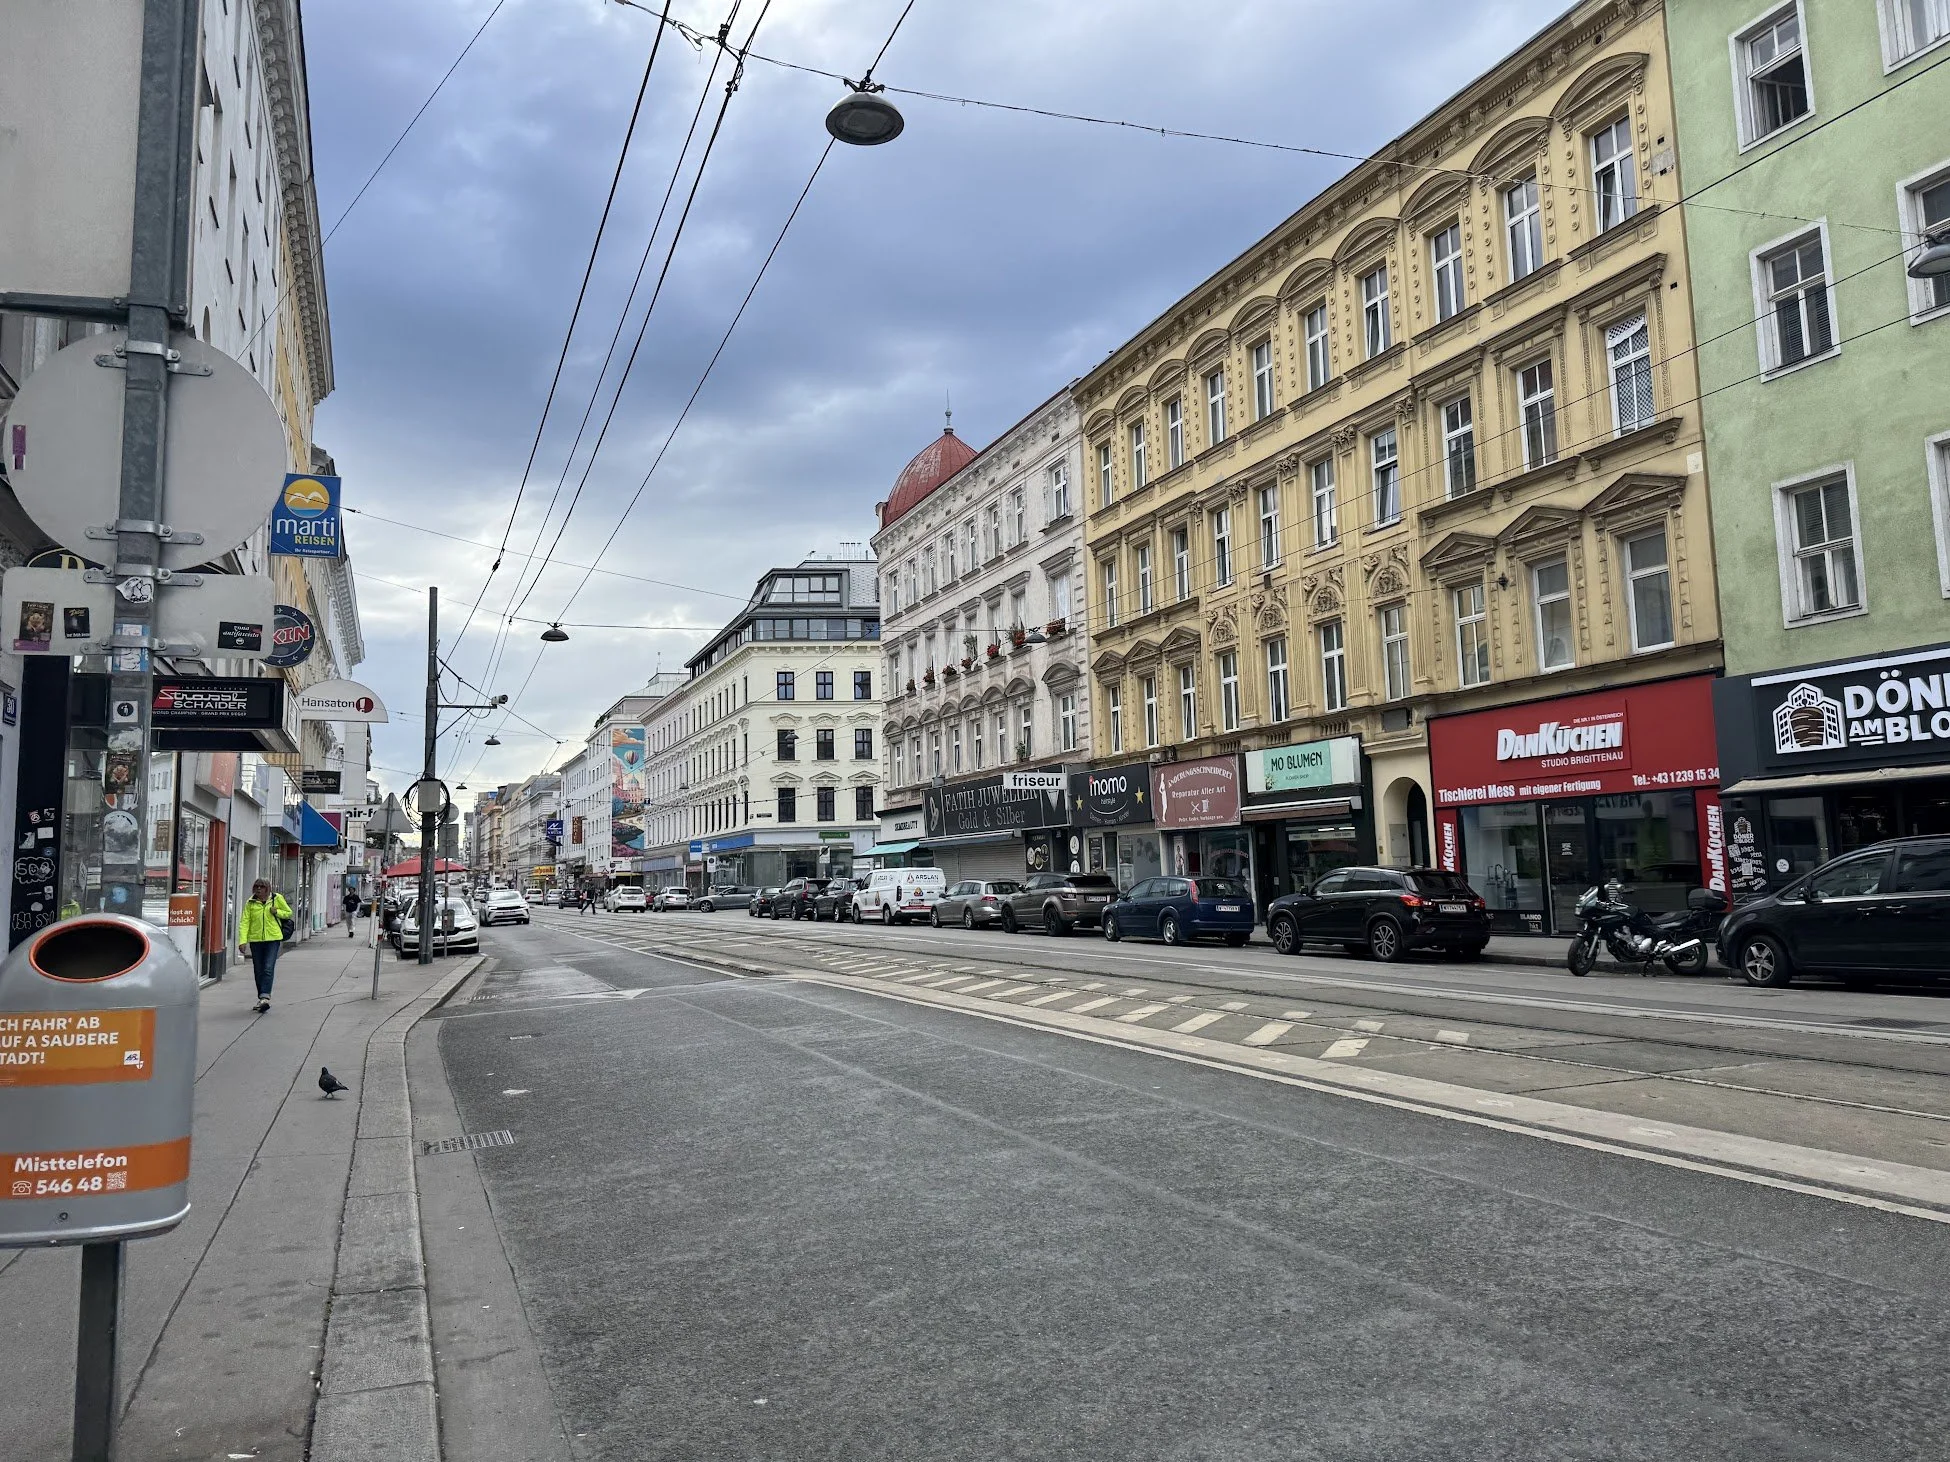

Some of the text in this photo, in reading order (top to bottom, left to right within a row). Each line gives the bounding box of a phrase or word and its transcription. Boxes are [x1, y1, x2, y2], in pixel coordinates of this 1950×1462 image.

[276, 517, 335, 537] marti
[294, 535, 335, 546] REISEN
[173, 701, 247, 709] SCHAIDER
[302, 698, 355, 708] Hansaton
[1271, 751, 1323, 772] MO BLUMEN
[1541, 751, 1624, 768] STUDIO BRIGITTENAU
[1012, 774, 1061, 787] friseur
[1651, 772, 1669, 784] +43
[1669, 771, 1675, 783] 1
[1676, 770, 1694, 782] 239
[1695, 769, 1707, 781] 15
[1708, 767, 1720, 779] 34
[1172, 785, 1226, 799] Reparatur Aller Art
[1438, 780, 1602, 802] Tischlerei Mess mit eigener Fertigung
[958, 806, 1025, 830] Gold & Silber
[76, 1016, 100, 1030] AB
[25, 1035, 38, 1048] A
[41, 1032, 119, 1048] SAUBERE
[14, 1153, 128, 1173] Misttelefon
[35, 1176, 103, 1195] 546 48
